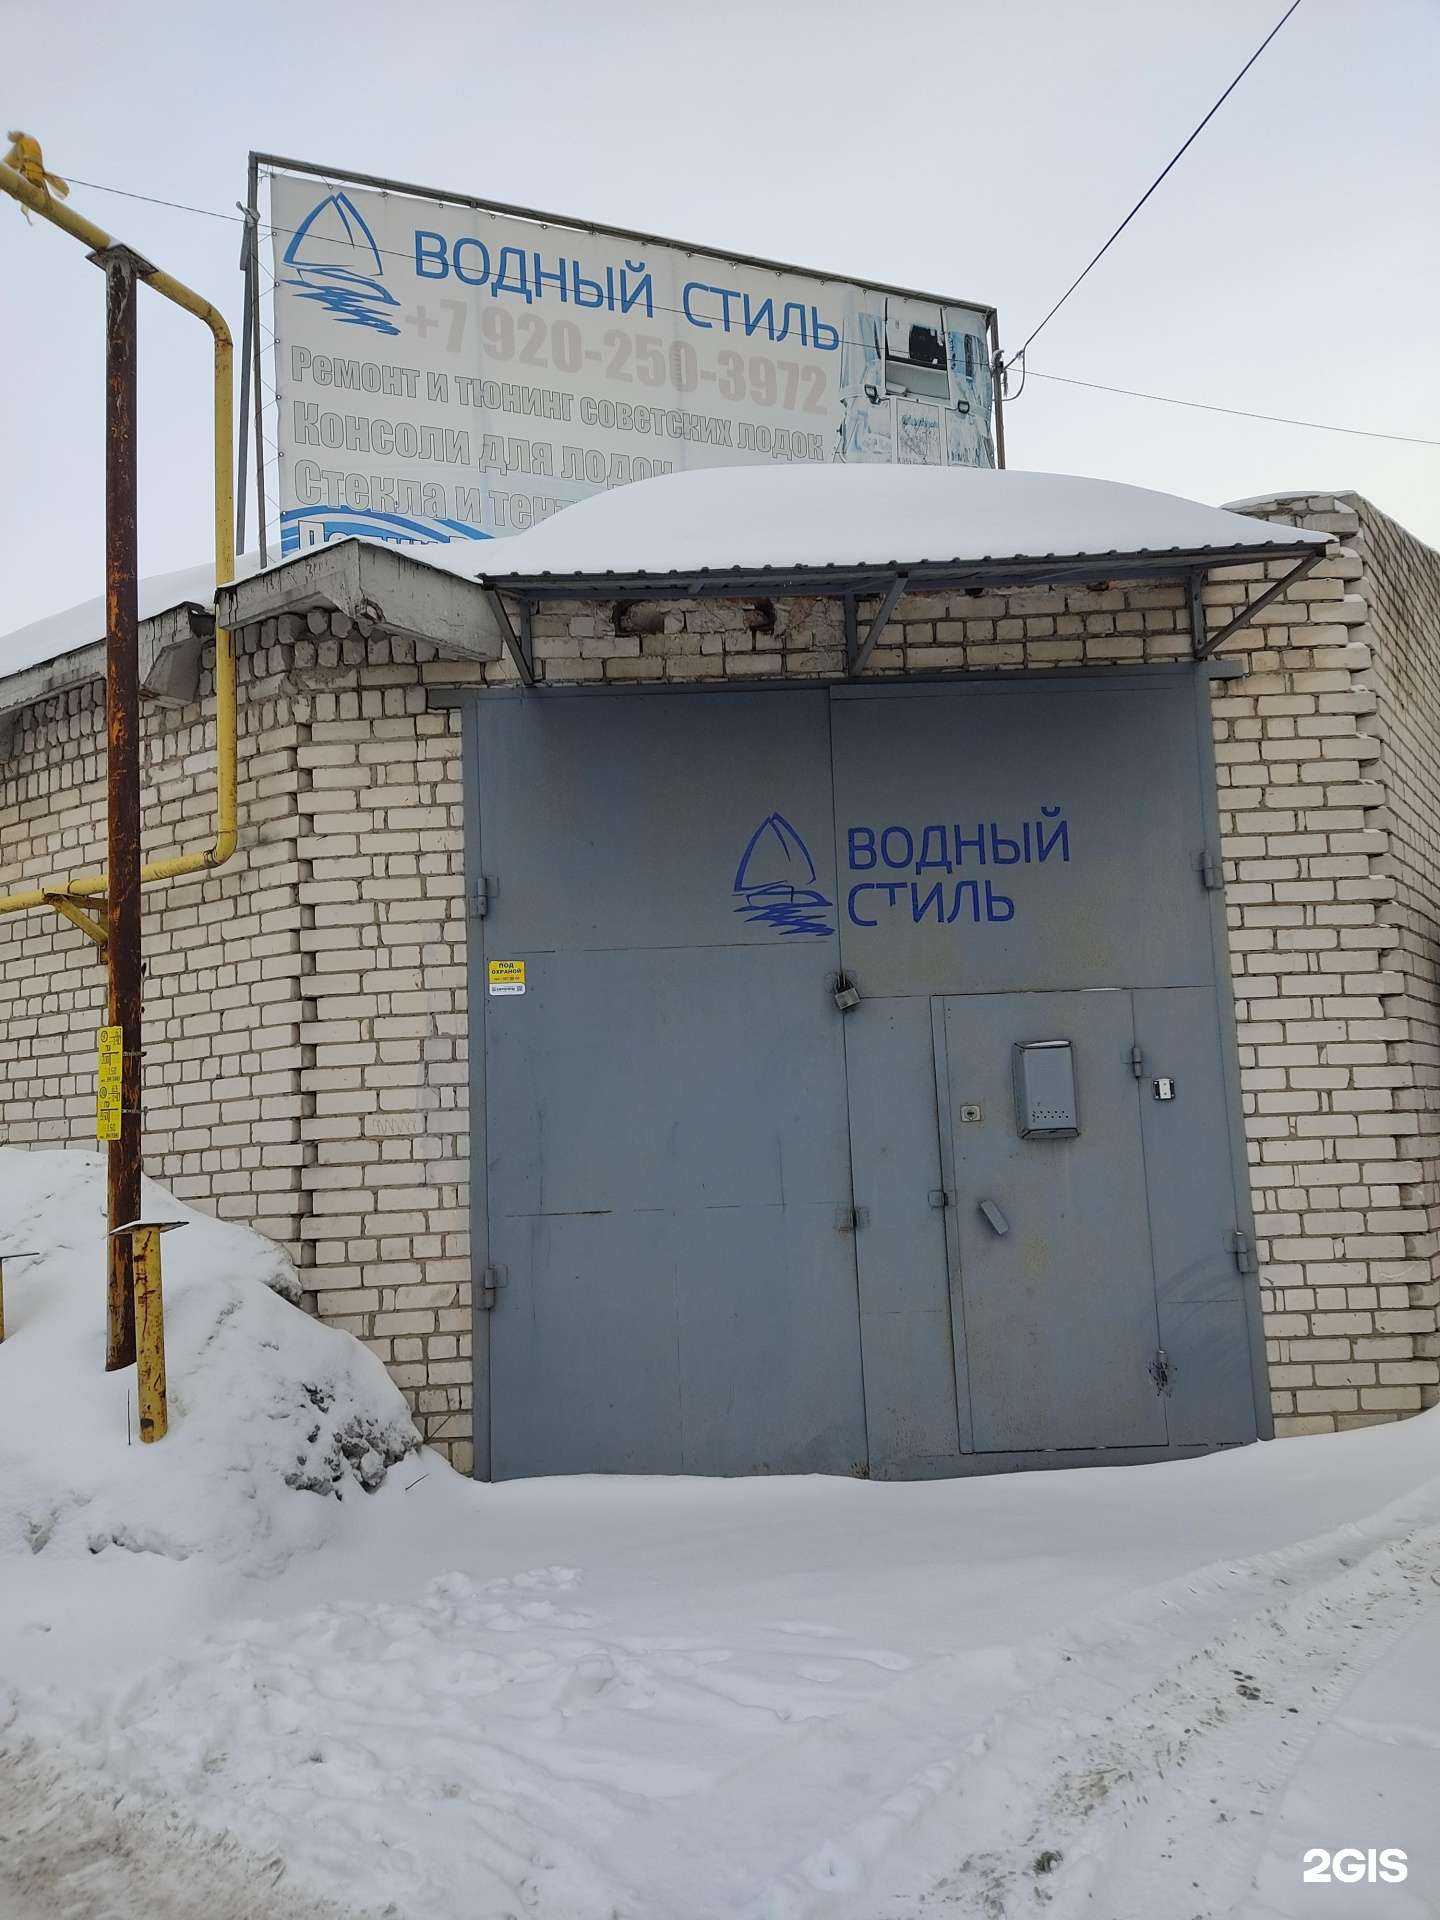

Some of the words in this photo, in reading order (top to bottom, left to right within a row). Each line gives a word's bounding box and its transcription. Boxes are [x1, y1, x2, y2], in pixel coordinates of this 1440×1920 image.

[414, 229, 654, 318] ВОДНЫЙ
[682, 281, 839, 351] СТИЛЬ
[405, 298, 468, 354] +7
[481, 304, 829, 416] 920-250-3972
[291, 345, 421, 399] Ремонт
[426, 371, 449, 403] и
[454, 375, 575, 422] тюнинг
[579, 396, 734, 448] советских
[737, 422, 826, 462] лодок
[293, 400, 471, 465] Консоли
[478, 433, 554, 477] для
[294, 459, 448, 520] Стекла
[454, 486, 482, 524] и
[847, 805, 1071, 876] ВОДНЫЙ
[847, 879, 1016, 928] СТИЛЬ
